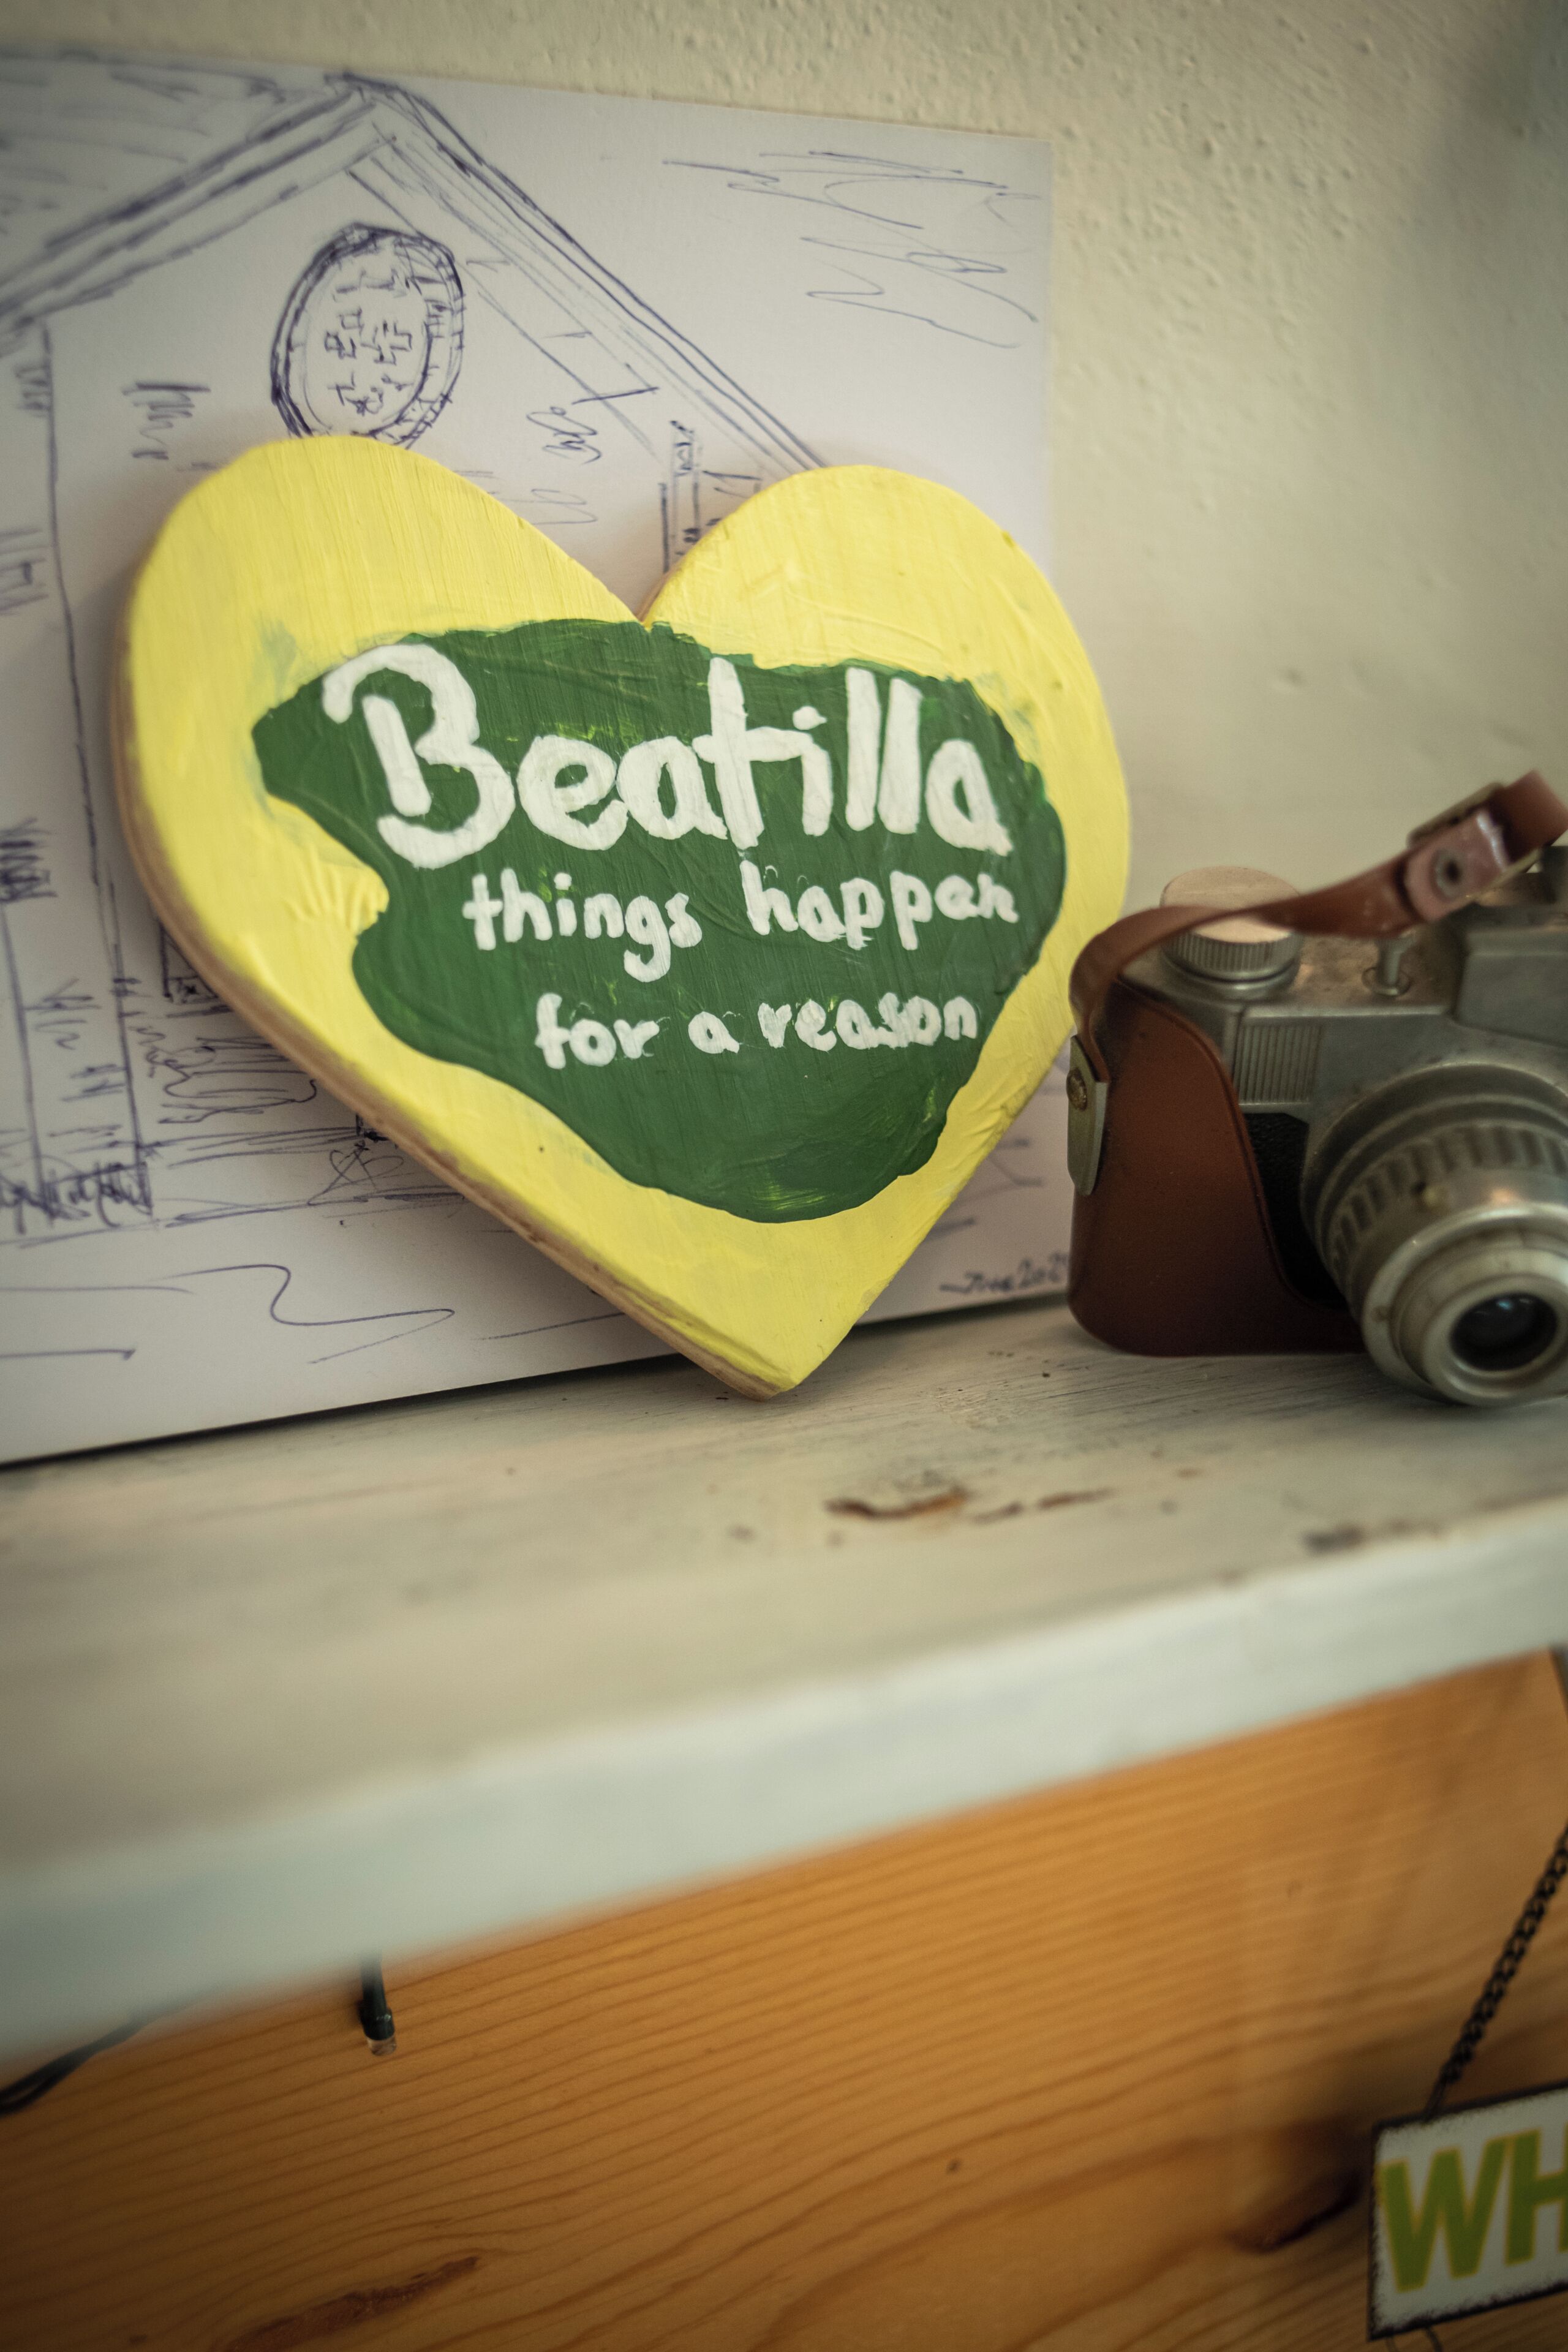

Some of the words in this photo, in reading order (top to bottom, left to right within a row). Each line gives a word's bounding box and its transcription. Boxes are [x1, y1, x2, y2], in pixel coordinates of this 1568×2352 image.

[322, 643, 1013, 869] Beatilla
[462, 867, 703, 982] things
[740, 859, 1019, 951] happen
[534, 992, 660, 1069] for
[688, 1011, 740, 1054] a
[757, 992, 978, 1051] reason
